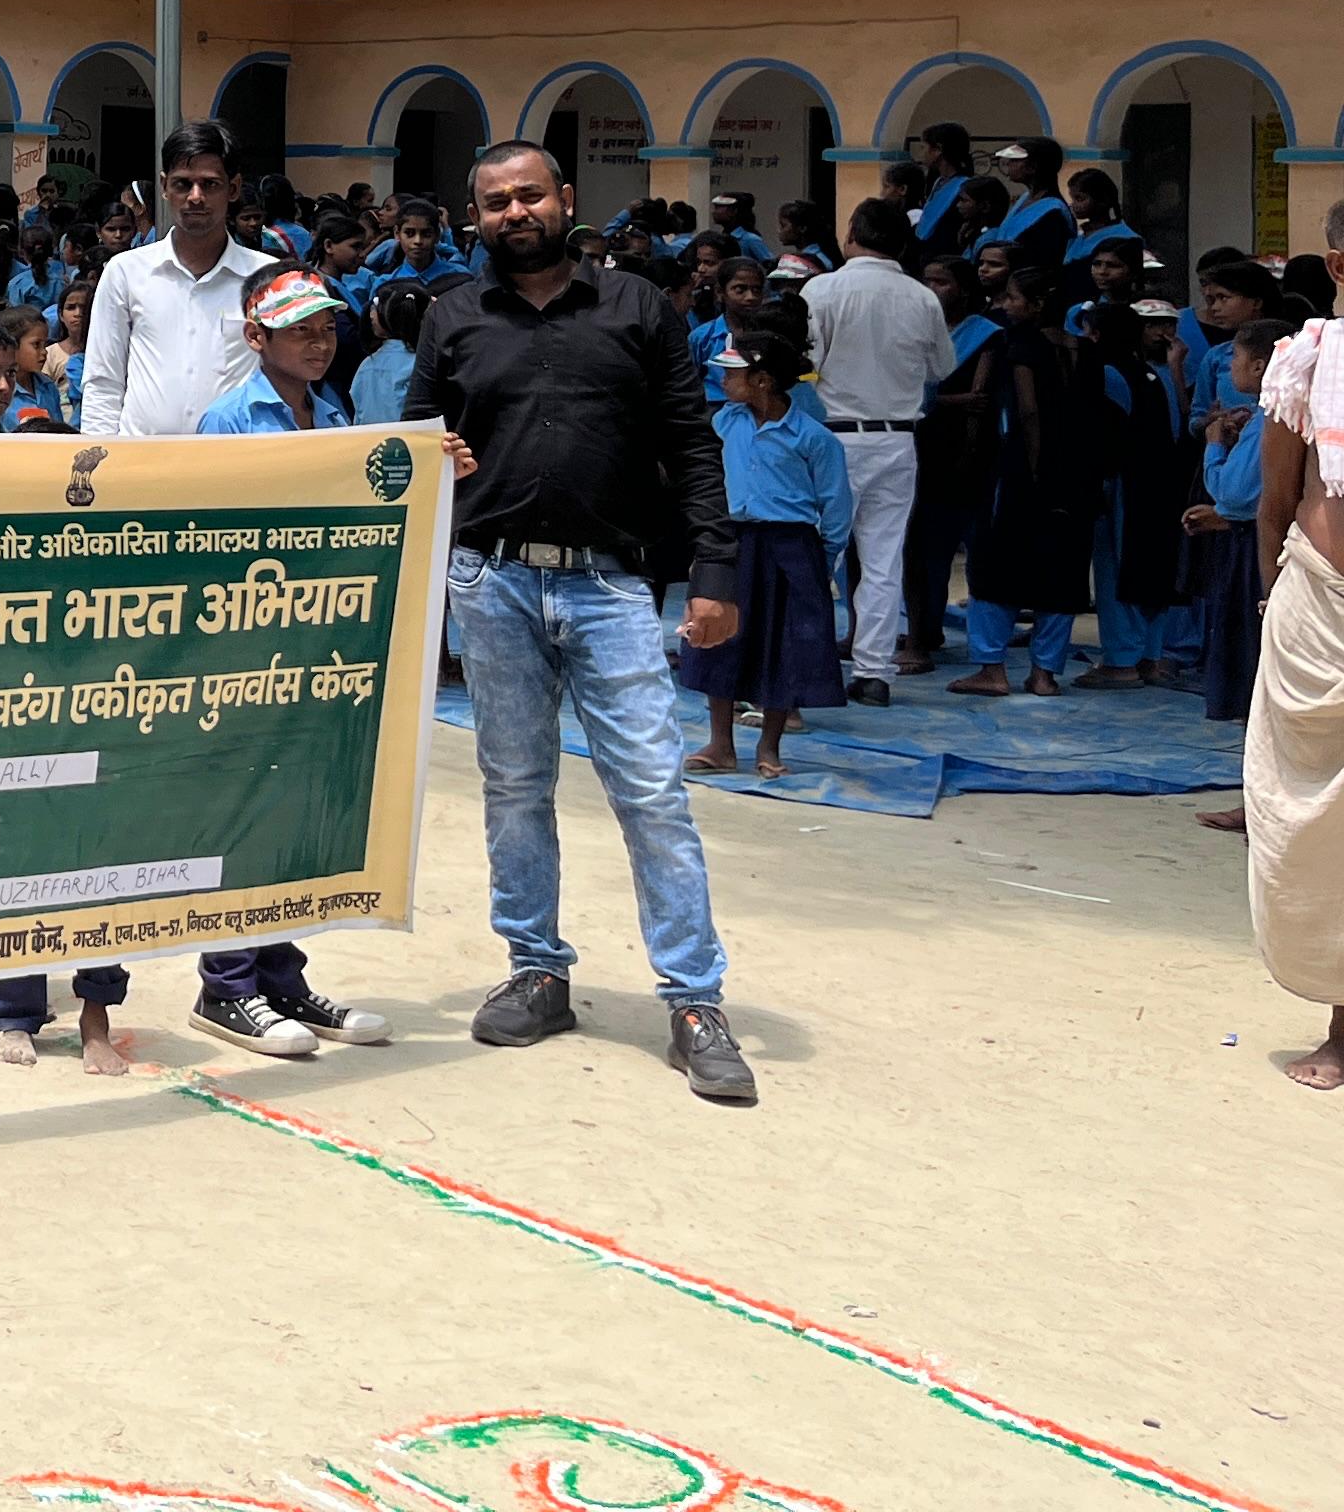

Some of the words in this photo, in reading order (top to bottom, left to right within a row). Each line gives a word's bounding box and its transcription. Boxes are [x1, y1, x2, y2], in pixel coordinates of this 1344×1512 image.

[38, 521, 169, 559] अधिकारिता
[174, 521, 261, 554] मंत्रालय
[266, 526, 324, 550] भारत
[329, 524, 401, 550] सरकार
[63, 585, 188, 639] भारत
[195, 558, 378, 635] अभियान
[70, 663, 196, 735] एकीकृत
[198, 652, 304, 732] पुनर्वास
[311, 650, 378, 706] केन्द्र
[135, 862, 190, 890] BIHAR
[31, 920, 68, 955] केन्द्र,
[187, 909, 222, 934] निकट
[224, 910, 245, 934] ब्लू
[244, 899, 281, 926] डायमंड
